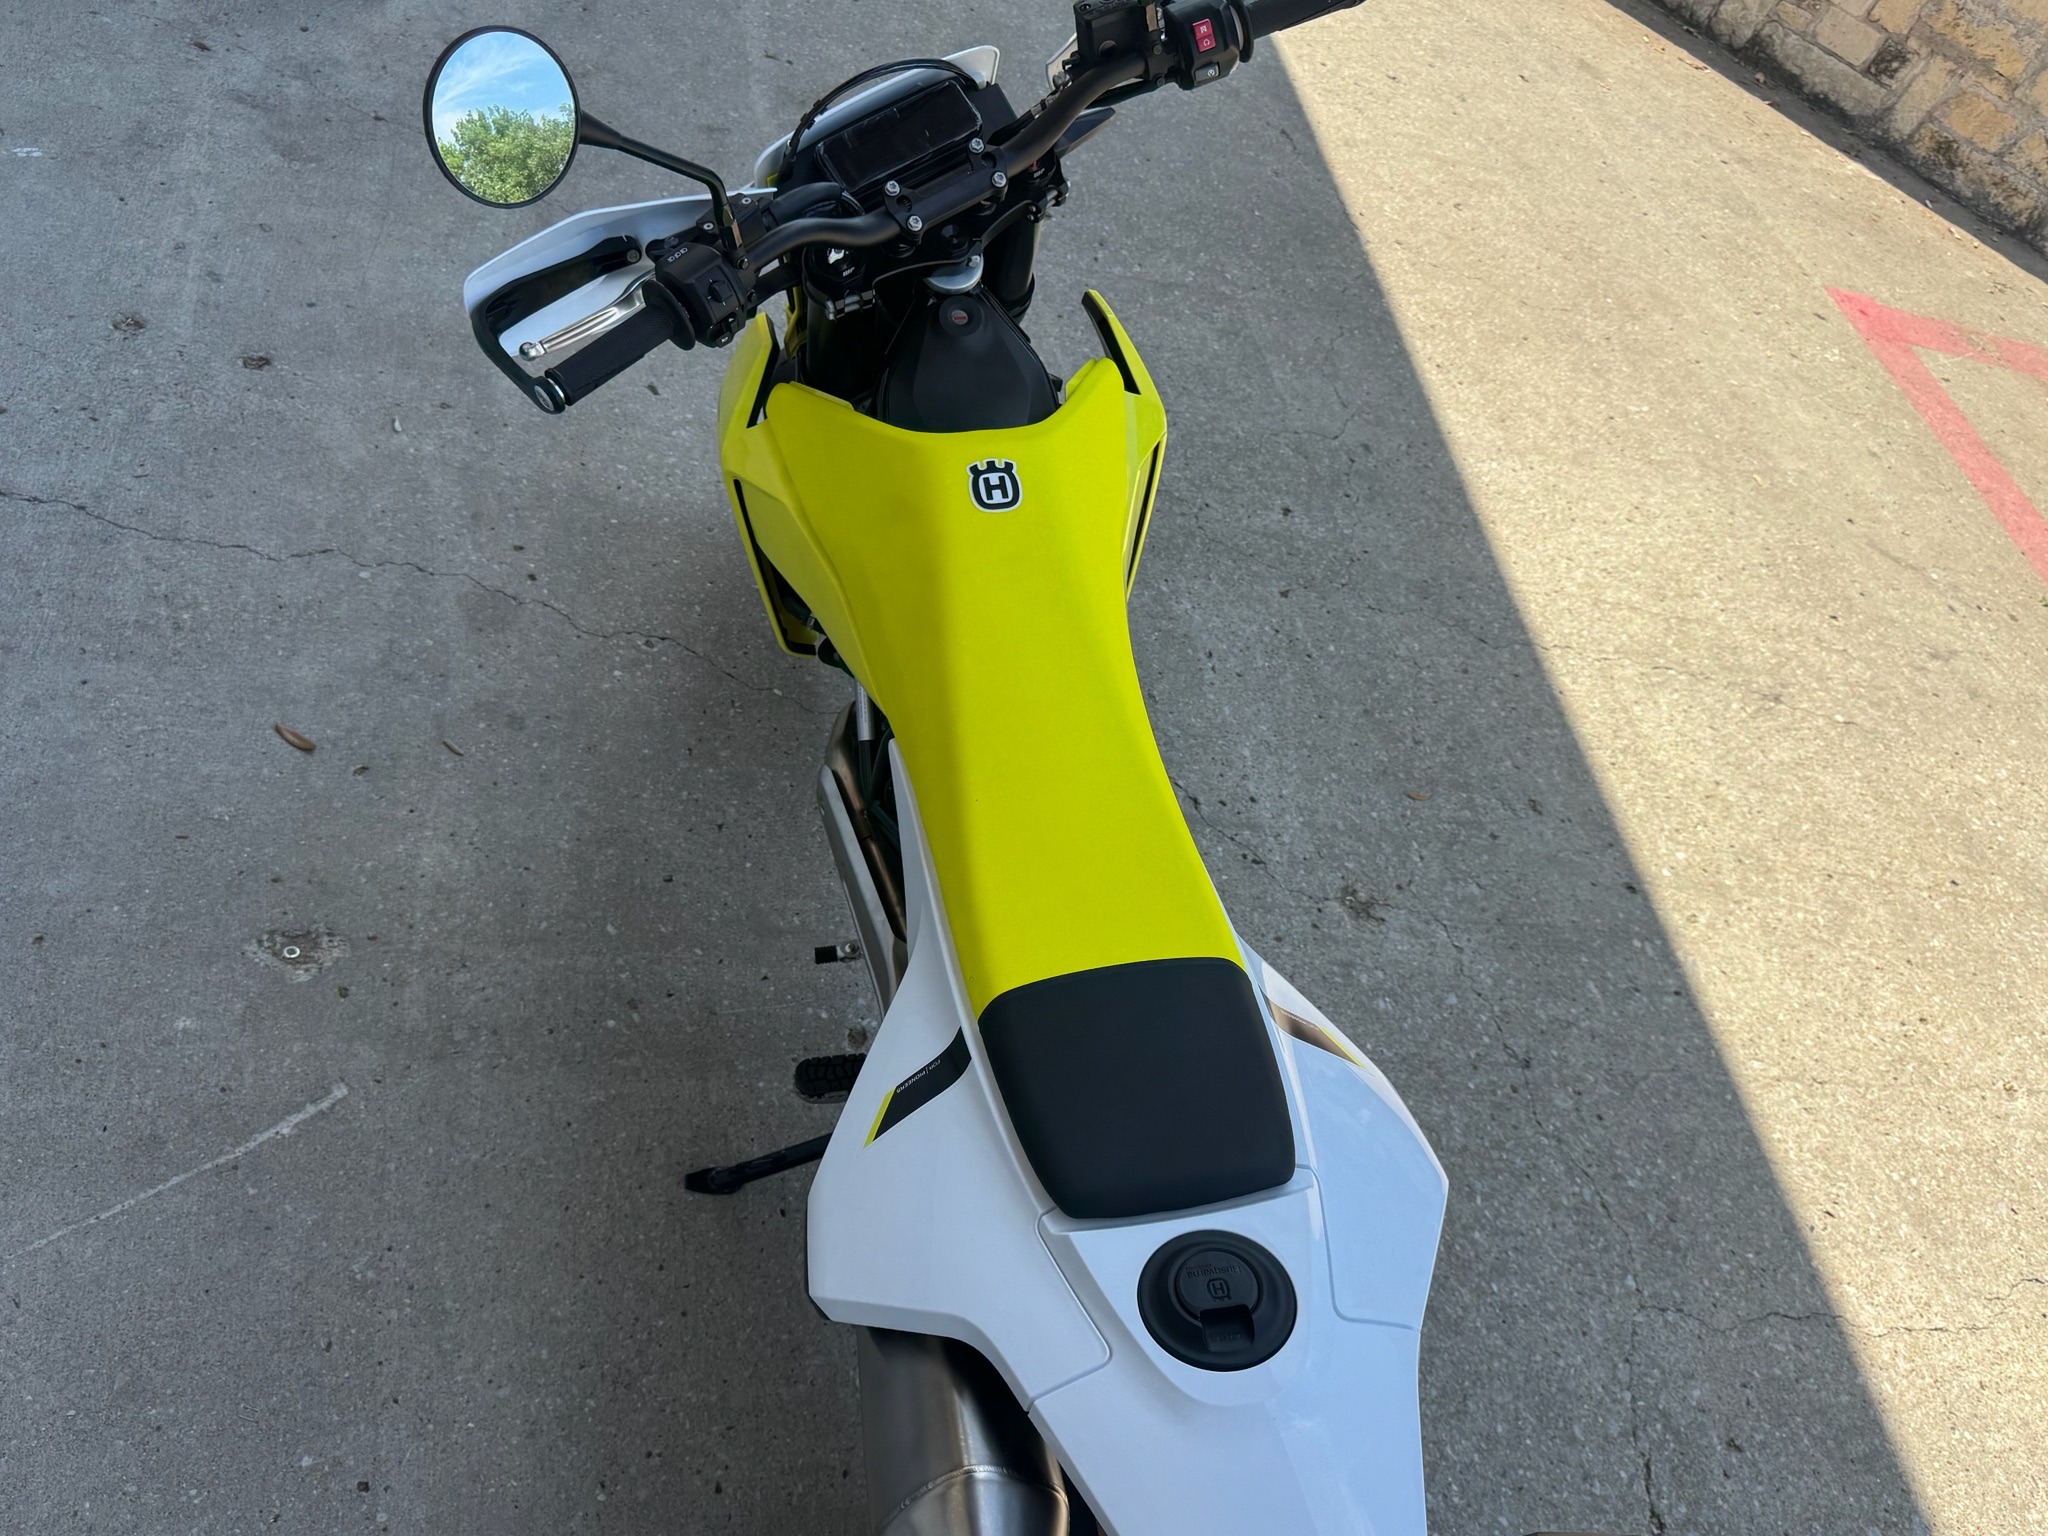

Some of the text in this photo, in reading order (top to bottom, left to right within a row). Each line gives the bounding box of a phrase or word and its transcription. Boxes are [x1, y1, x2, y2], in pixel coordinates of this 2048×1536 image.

[982, 475, 1010, 501] H
[928, 1059, 942, 1071] FOR
[1186, 1265, 1241, 1279] Husqvarna
